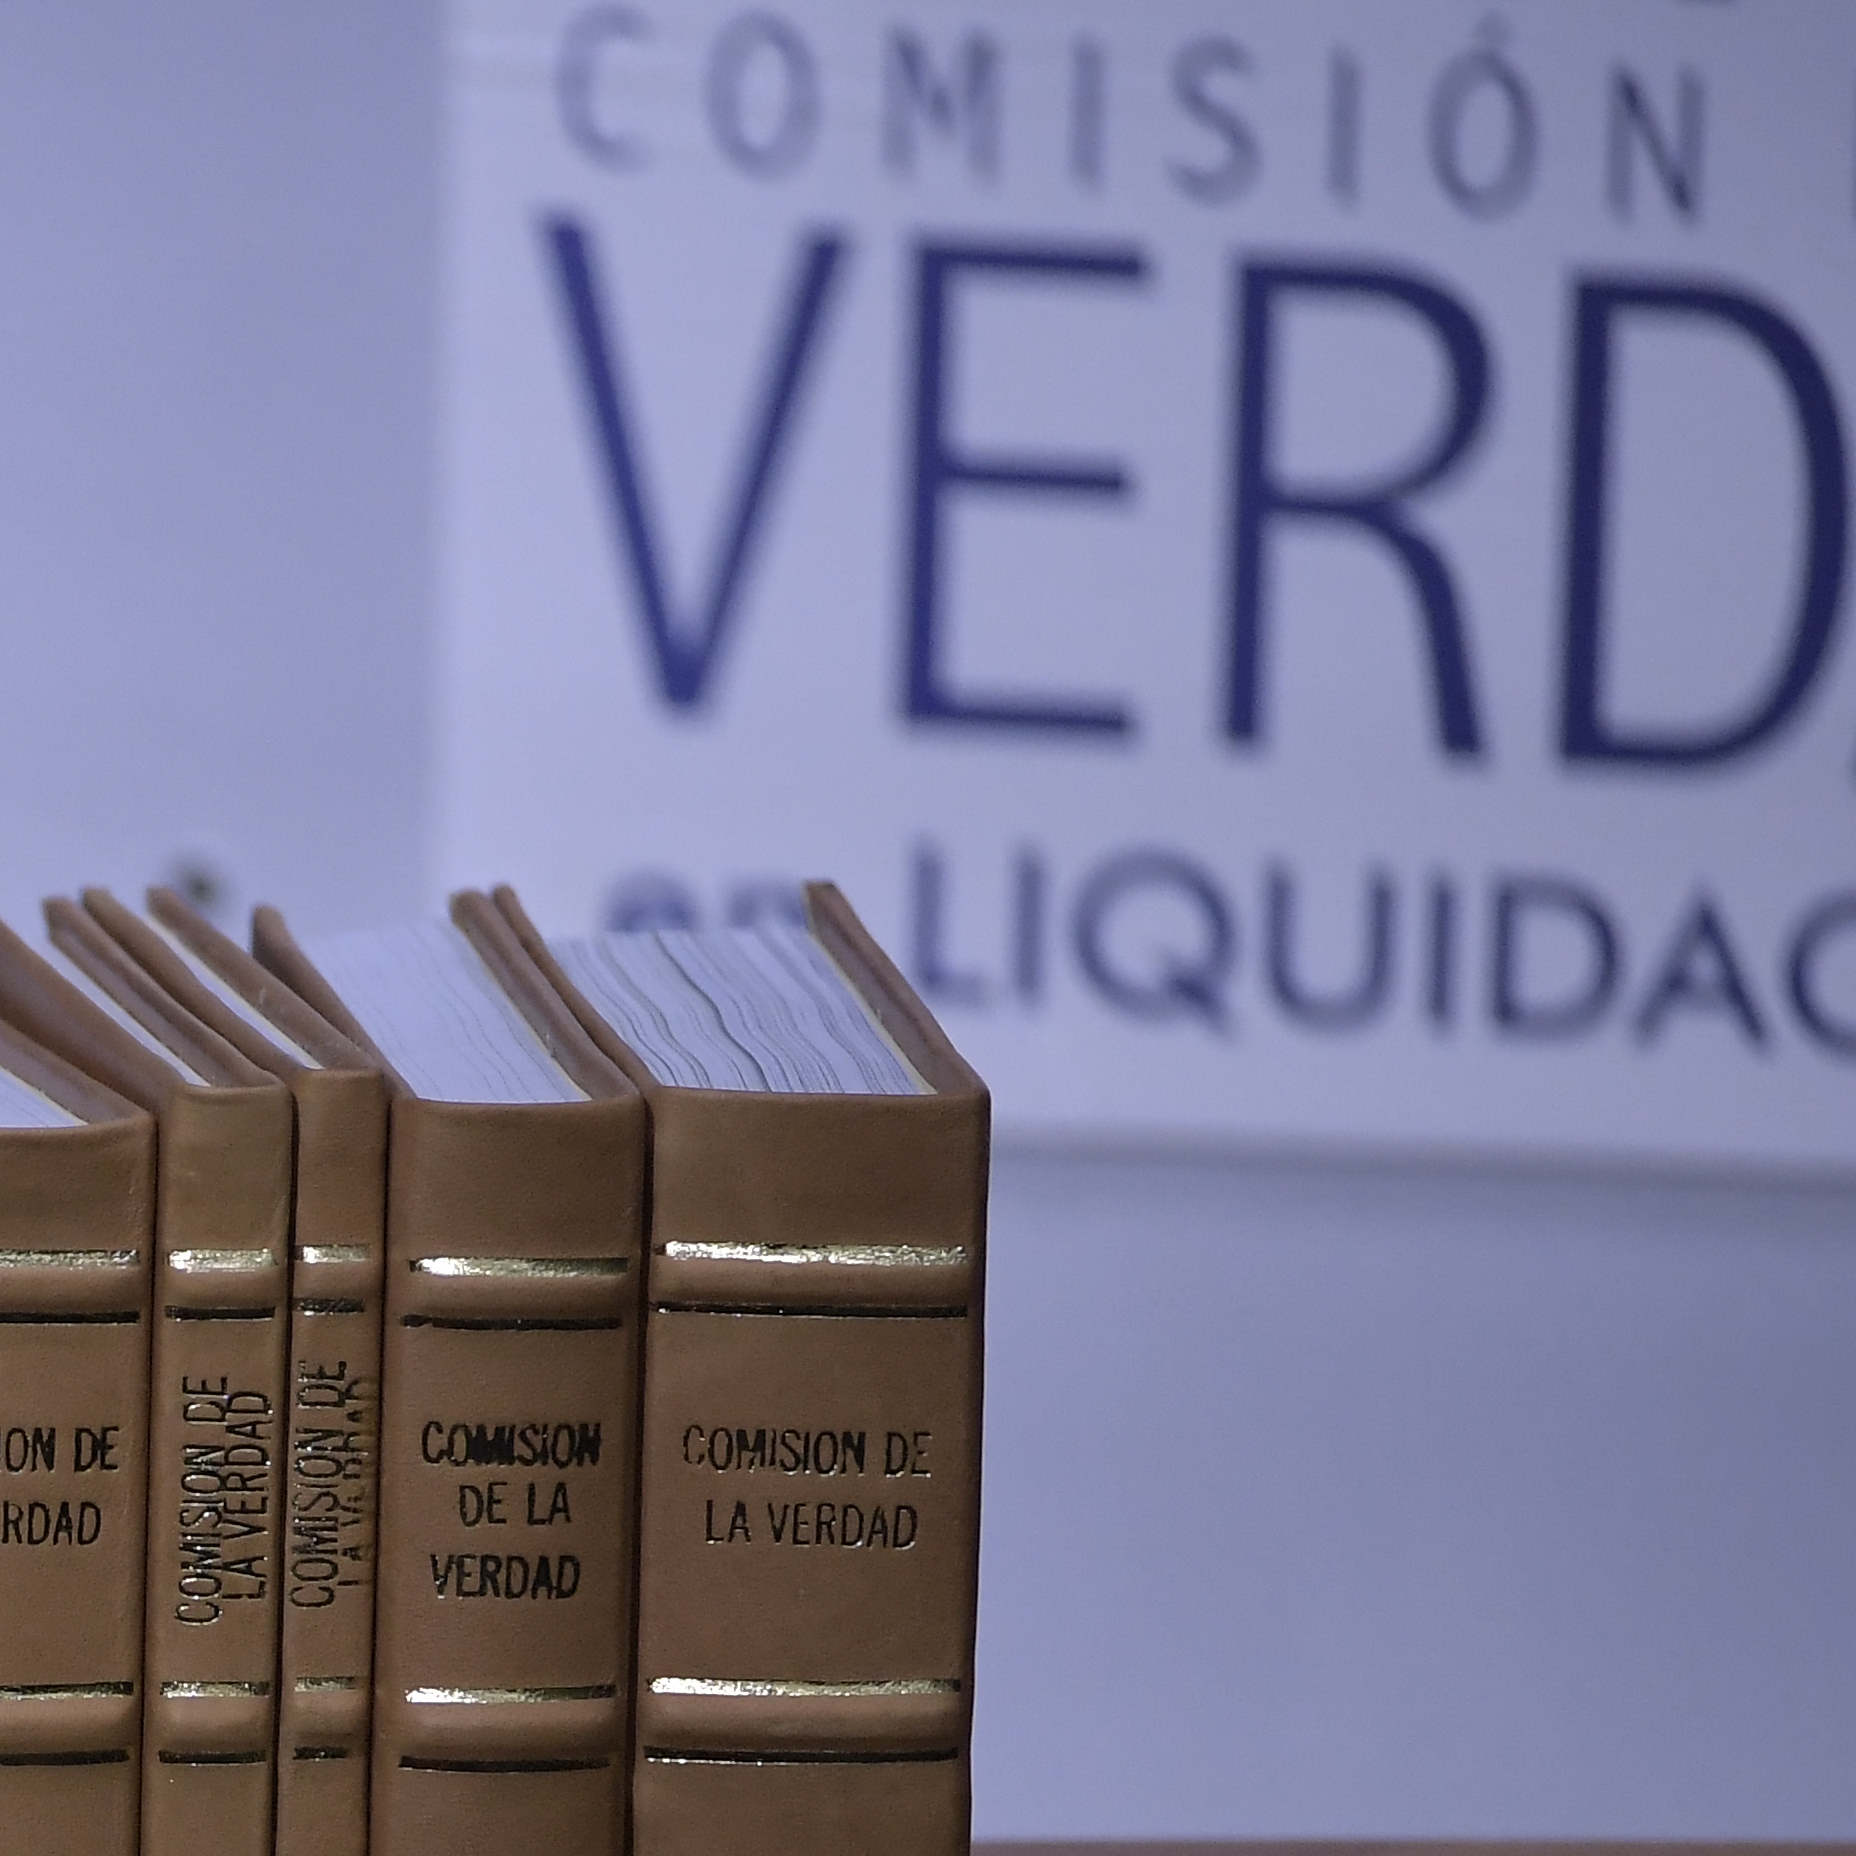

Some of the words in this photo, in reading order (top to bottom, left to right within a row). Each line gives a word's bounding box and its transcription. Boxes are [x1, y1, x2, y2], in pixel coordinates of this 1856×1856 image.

[556, 8, 1709, 224] COMISIÓN
[182, 1375, 229, 1424] DE
[297, 1360, 347, 1408] DE
[75, 1426, 119, 1472] DE
[224, 1390, 273, 1540] VERDAD
[422, 1421, 601, 1469] COMISION
[683, 1424, 865, 1476] COMISION
[884, 1431, 932, 1477] DE
[289, 1428, 346, 1609] COMISION
[459, 1482, 508, 1527] DE
[527, 1482, 571, 1525] LA
[705, 1499, 752, 1545] LA
[768, 1502, 918, 1550] VERDAD
[175, 1443, 229, 1627] COMISION
[222, 1556, 269, 1600] LA
[431, 1554, 580, 1600] VERDAD
